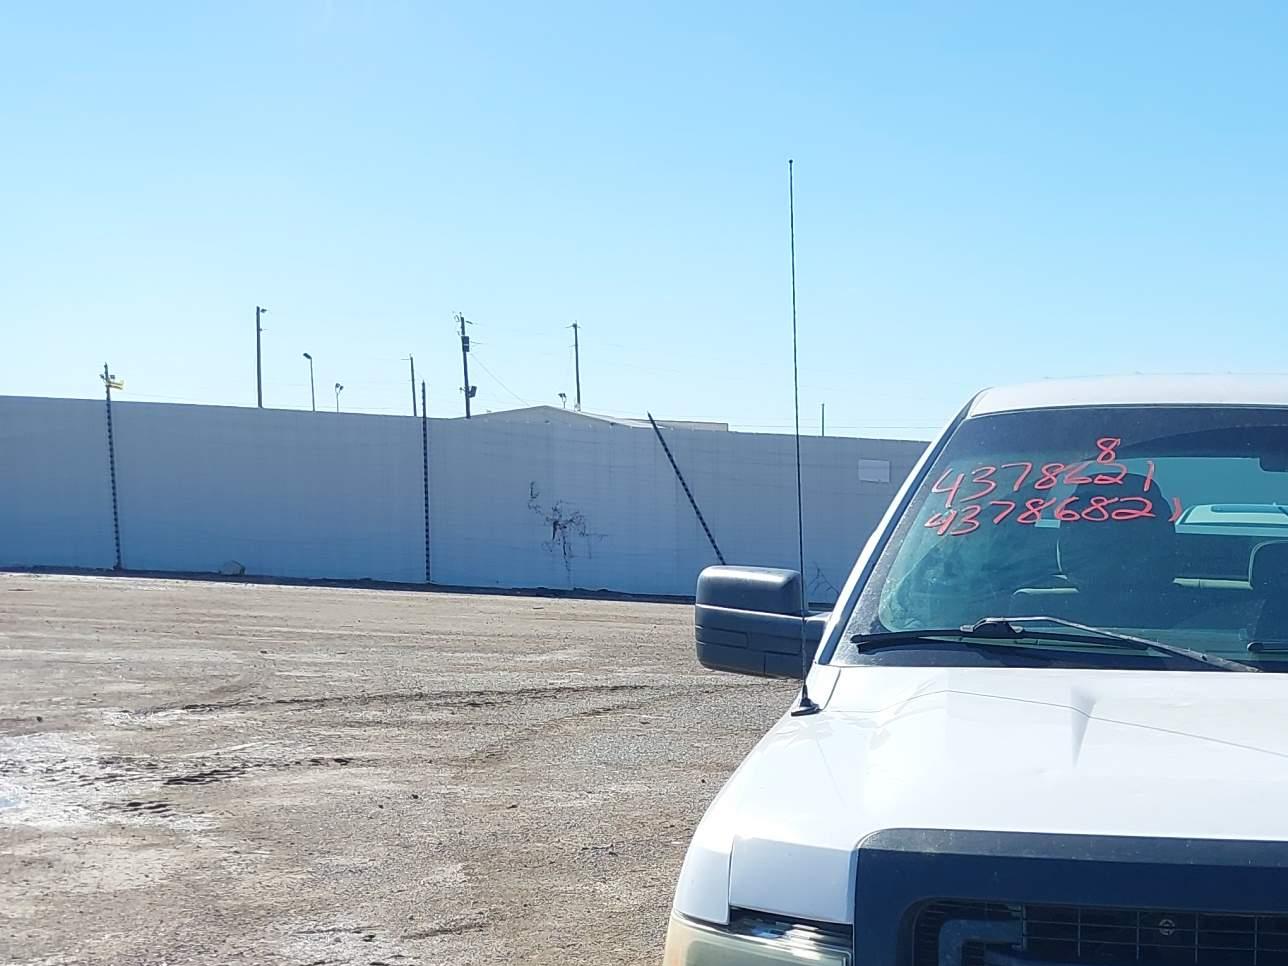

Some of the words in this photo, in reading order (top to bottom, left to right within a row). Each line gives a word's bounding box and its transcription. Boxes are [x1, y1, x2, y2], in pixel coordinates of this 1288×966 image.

[1096, 437, 1121, 464] 8
[931, 460, 1156, 508] 4378621
[924, 496, 1183, 536] 43786821
